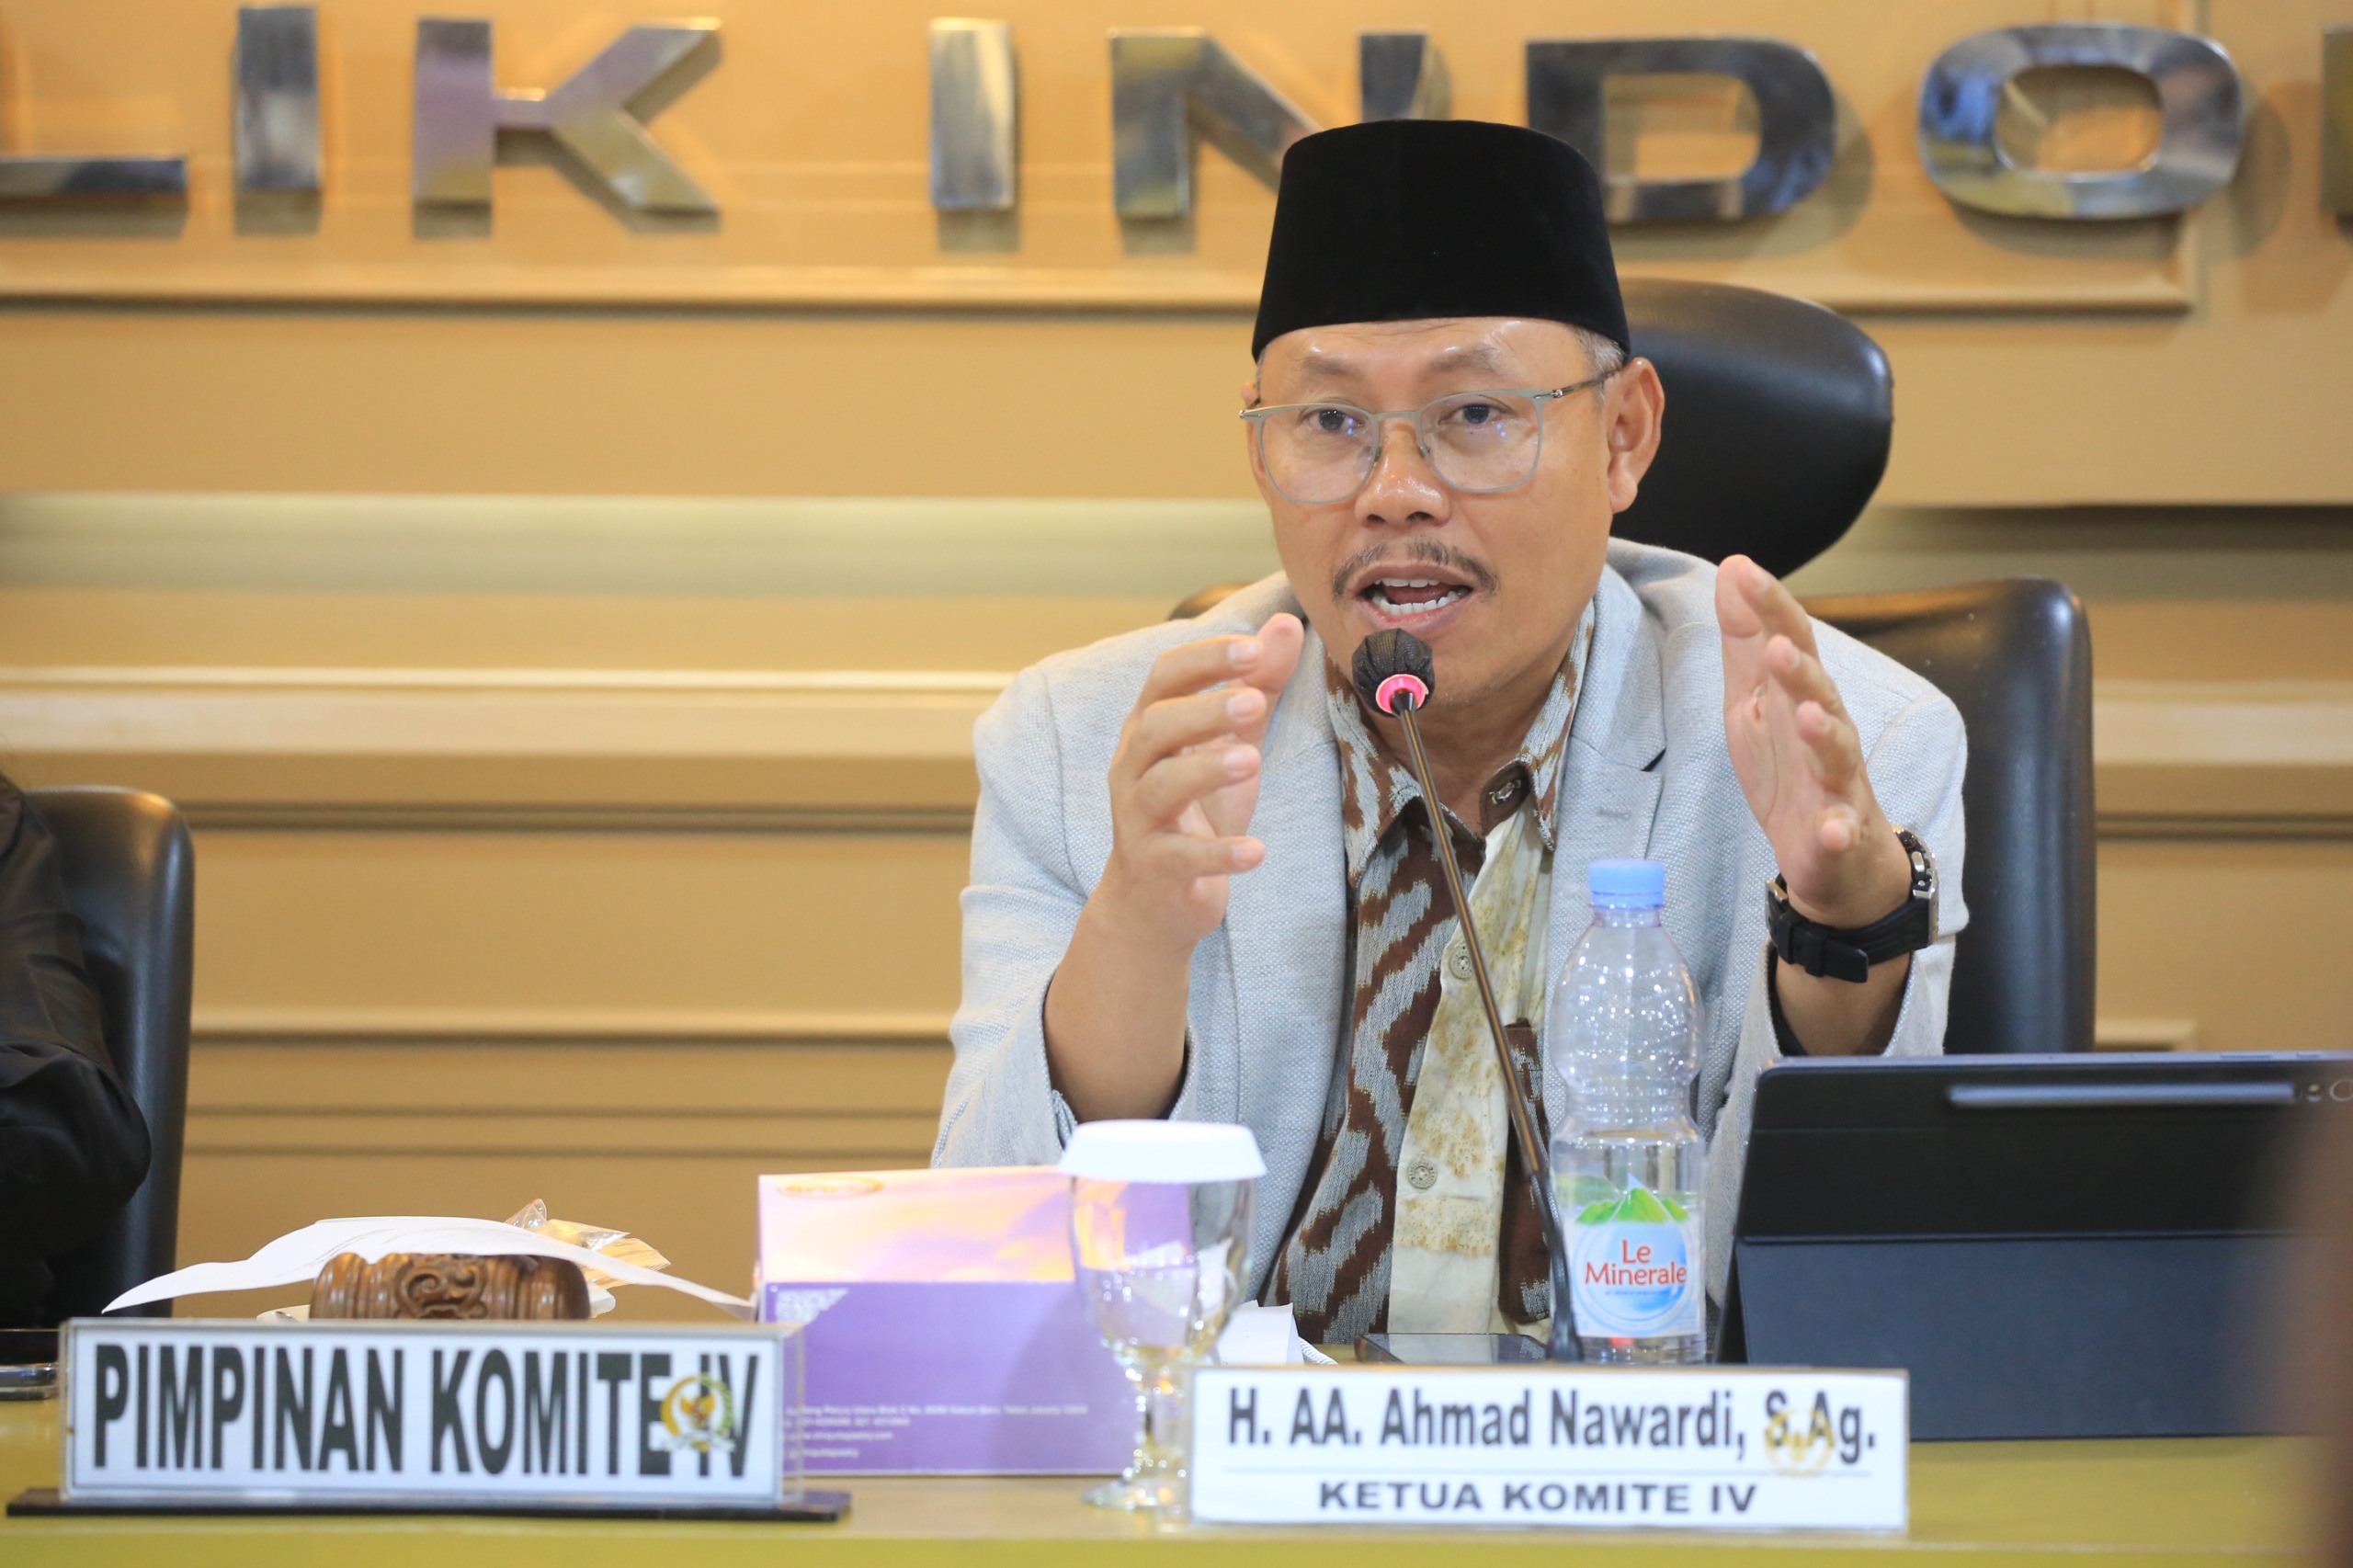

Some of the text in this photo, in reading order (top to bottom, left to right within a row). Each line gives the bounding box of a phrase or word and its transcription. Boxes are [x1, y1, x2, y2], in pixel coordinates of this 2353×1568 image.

[929, 18, 2353, 221] INDO
[1584, 1260, 1688, 1287] Minerale
[1620, 1238, 1652, 1265] Le
[93, 1343, 759, 1478] PIMPINAN KOMITE IV
[1228, 1387, 1877, 1466] H. AA. Ahmad Nawardi, S.Ag.
[1318, 1482, 1759, 1514] KETUA KOMITE IV
